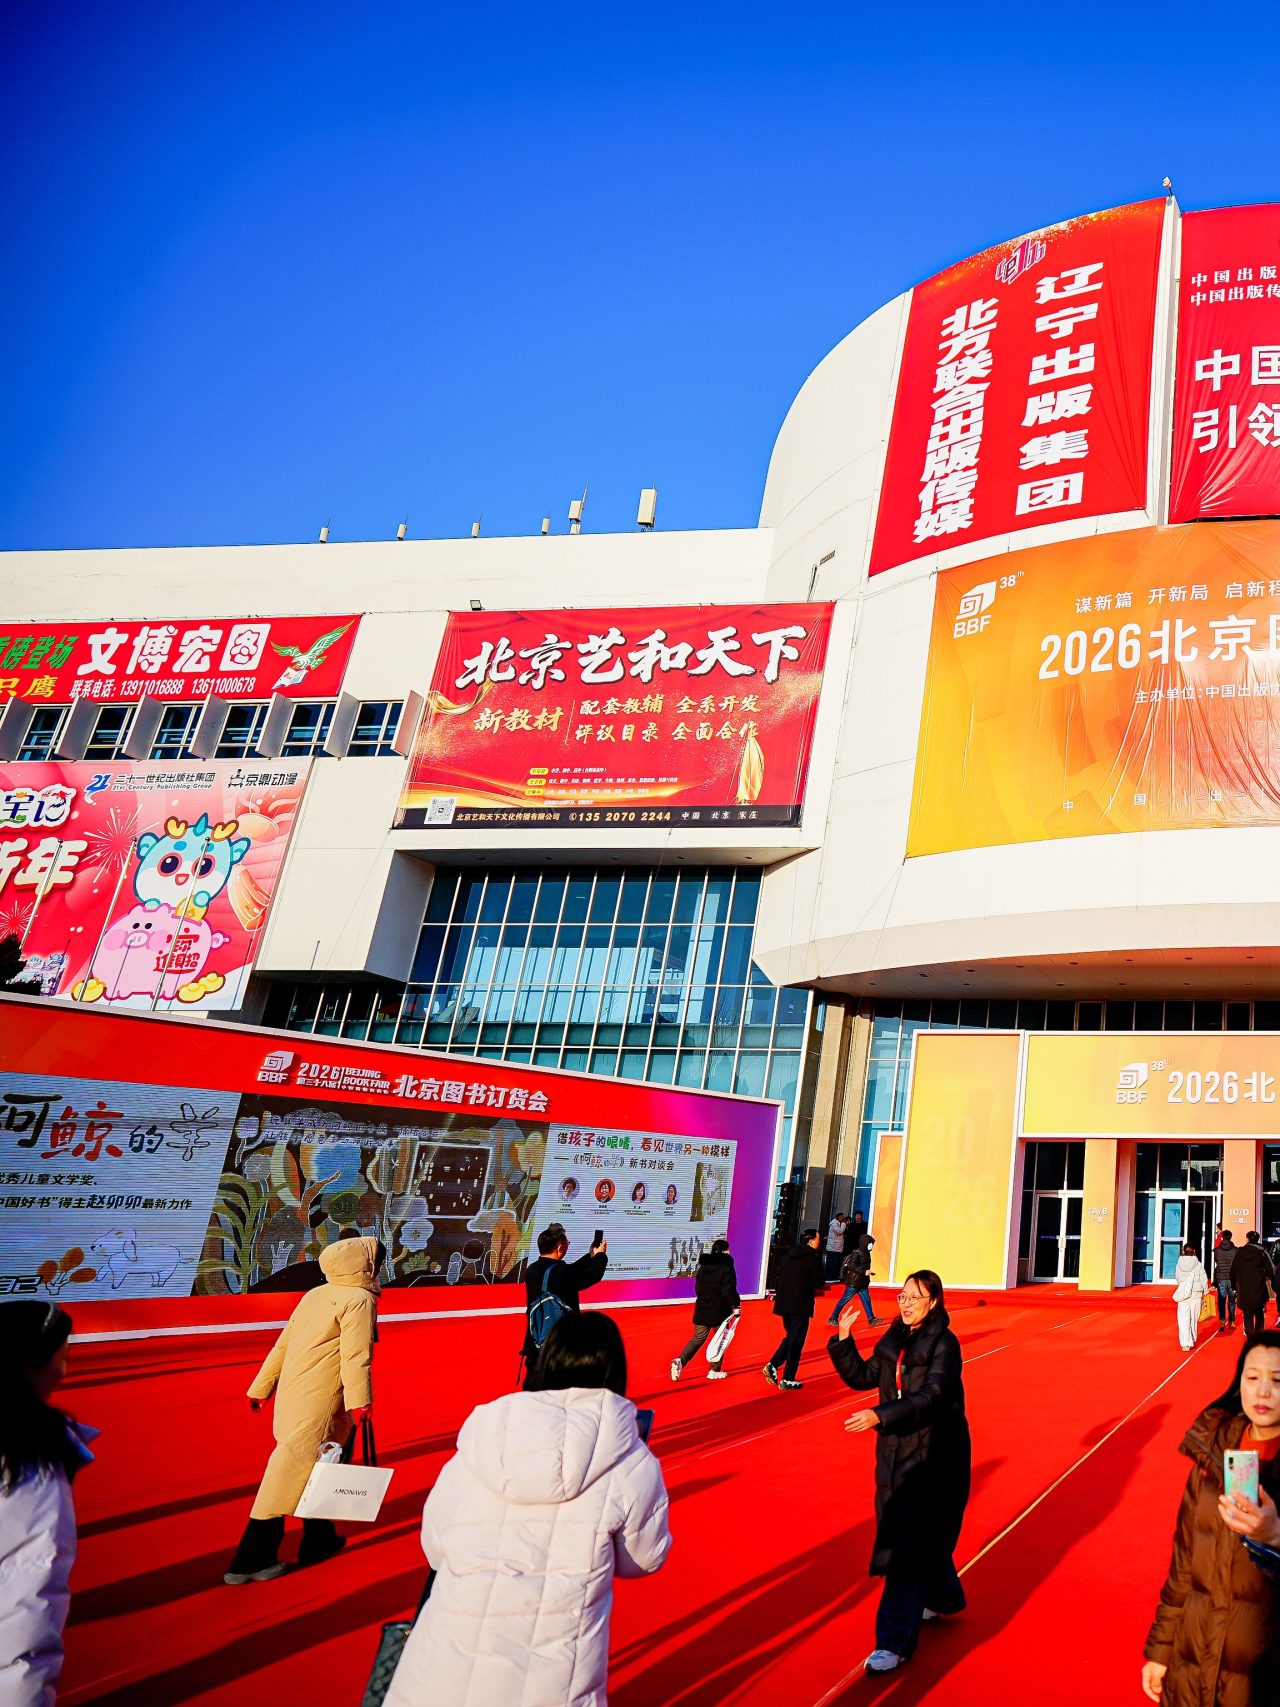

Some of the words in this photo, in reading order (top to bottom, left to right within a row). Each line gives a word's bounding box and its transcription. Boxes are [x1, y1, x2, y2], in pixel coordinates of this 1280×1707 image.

[1015, 262, 1104, 516] 辽宁出版集团
[912, 297, 1000, 544] 北方联合出版传媒
[1075, 591, 1134, 615] 谋新篇
[1148, 584, 1209, 605] 开新局
[953, 614, 992, 639] BBF
[77, 623, 272, 676] 文博宏图
[455, 624, 807, 690] 北京艺和天下
[120, 678, 186, 696] 13911016888
[192, 676, 257, 694] 13611000678
[473, 706, 564, 735] 新教材
[579, 693, 664, 715] 配套教辅
[675, 694, 761, 714] 全系开发
[575, 721, 660, 744] 评议目录
[671, 721, 759, 742] 全面合作
[115, 772, 216, 784] 二十一世纪出版社集团
[244, 772, 299, 787] 京鼎动漫
[578, 812, 600, 822] 135
[605, 812, 635, 822] 2070
[641, 812, 671, 821] 2244
[257, 1071, 289, 1084] BBF
[298, 1062, 341, 1080] 2026
[345, 1067, 382, 1079] BEIJING
[343, 1076, 370, 1087] BOOK
[370, 1079, 391, 1089] FAIR
[393, 1074, 549, 1113] 北京图书订货会
[1116, 1090, 1147, 1104] BBF
[0, 1193, 193, 1211] 国好书”得主赵卯卯最新力作
